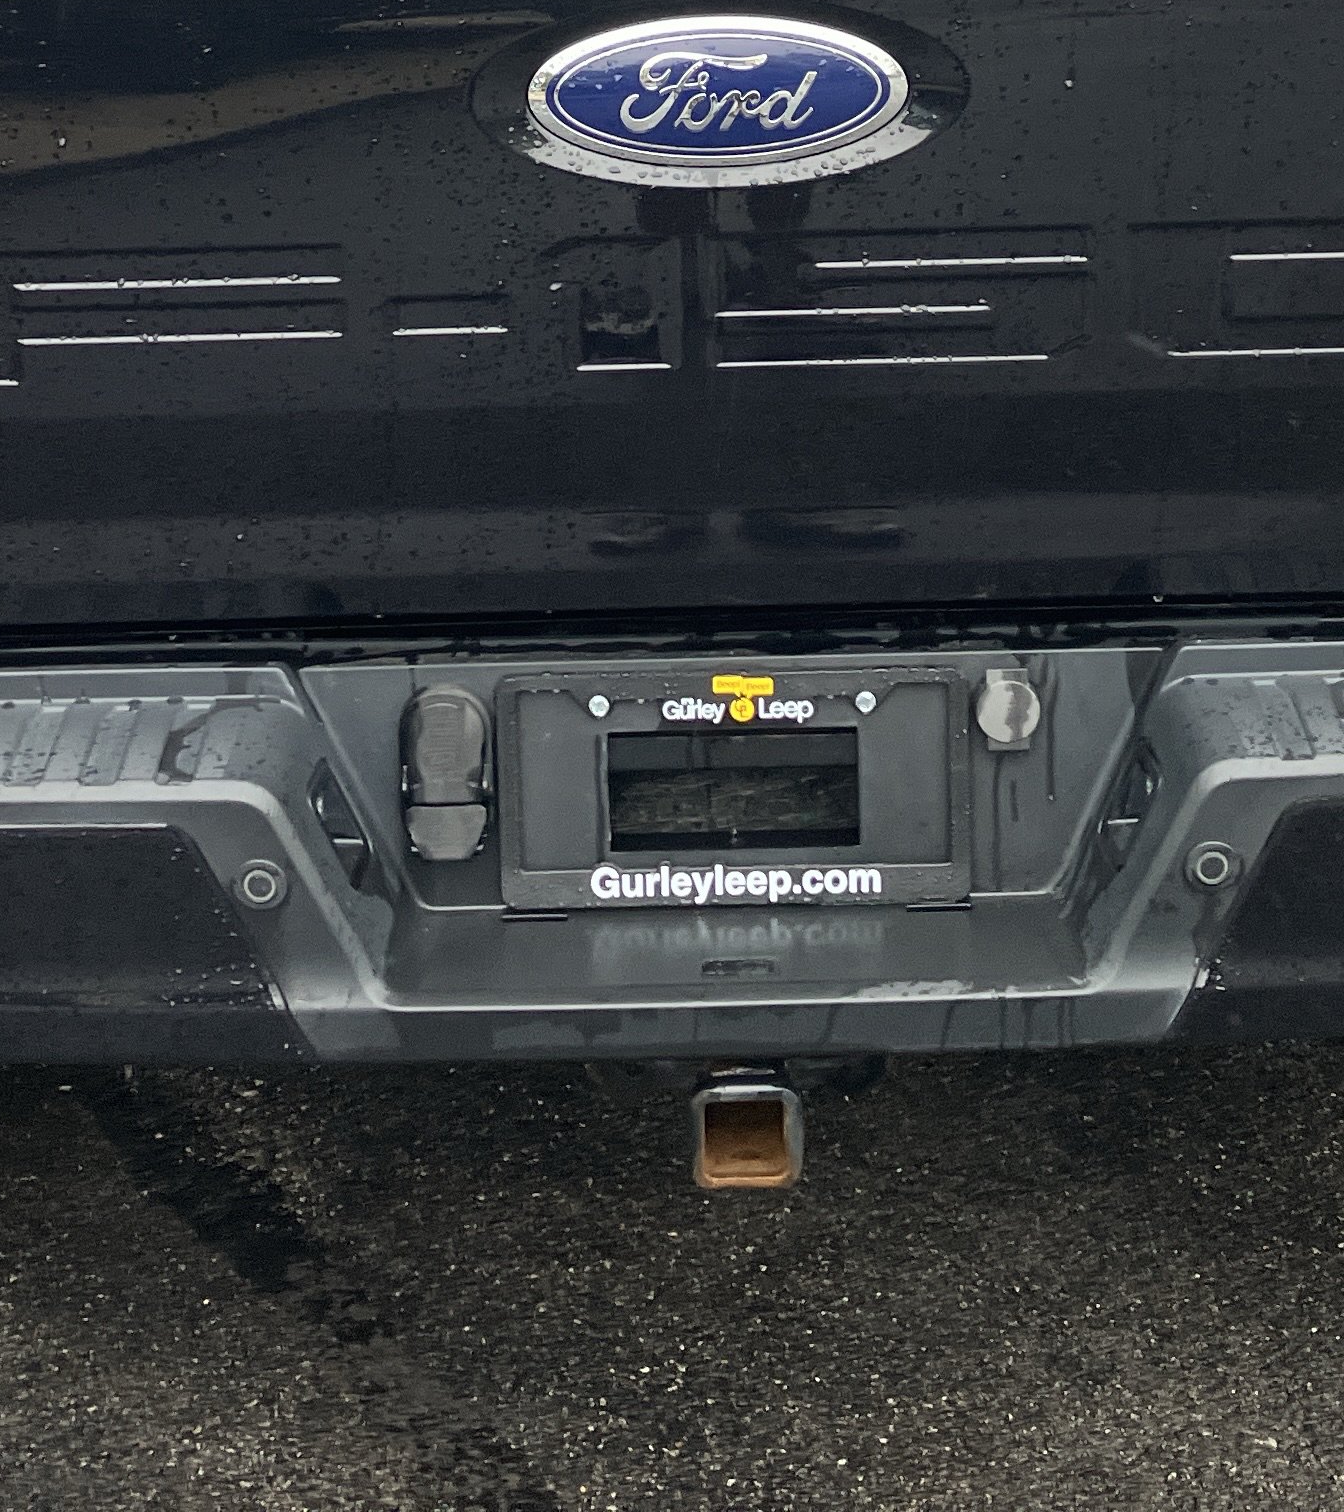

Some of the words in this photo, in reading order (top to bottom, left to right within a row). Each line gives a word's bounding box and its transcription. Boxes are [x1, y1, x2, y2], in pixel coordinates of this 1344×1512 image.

[619, 51, 819, 134] Ford
[758, 697, 815, 724] Leep
[590, 864, 882, 904] Gurleyleep.com
